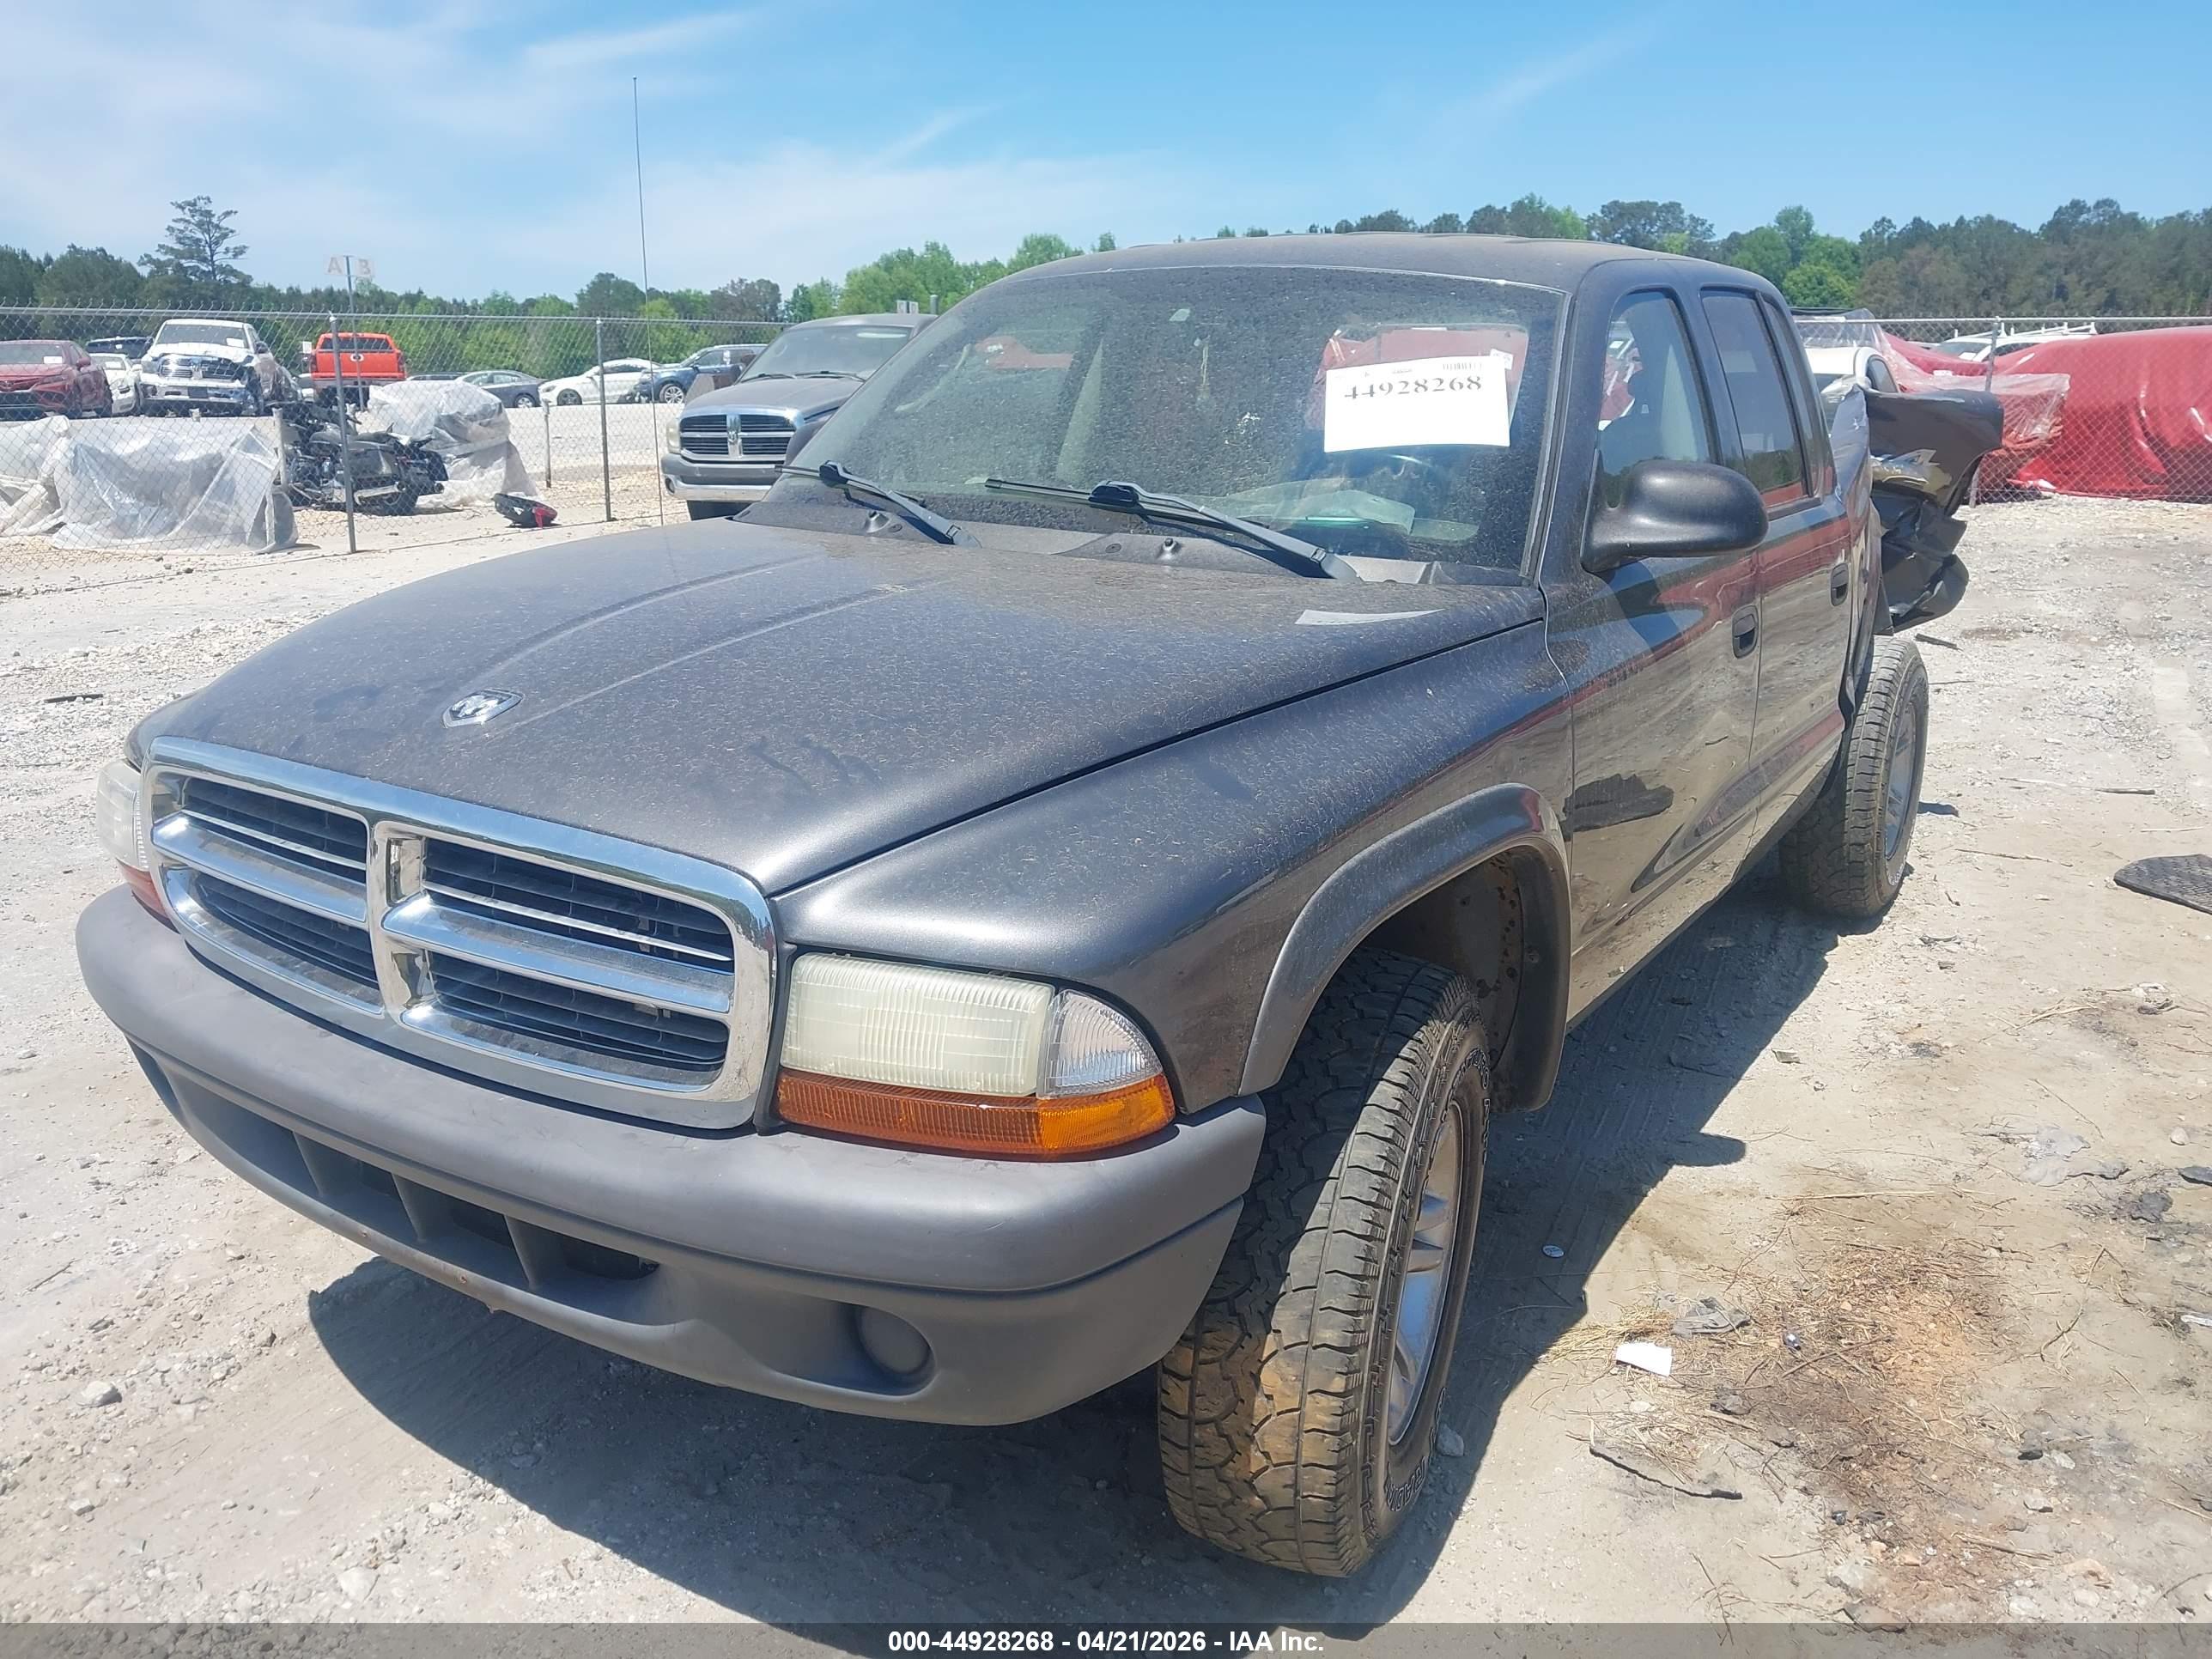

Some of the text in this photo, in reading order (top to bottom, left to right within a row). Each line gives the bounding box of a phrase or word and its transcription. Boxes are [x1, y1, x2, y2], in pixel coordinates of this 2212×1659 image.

[327, 257, 343, 273] A
[358, 258, 371, 275] B
[1344, 375, 1482, 399] 44928268
